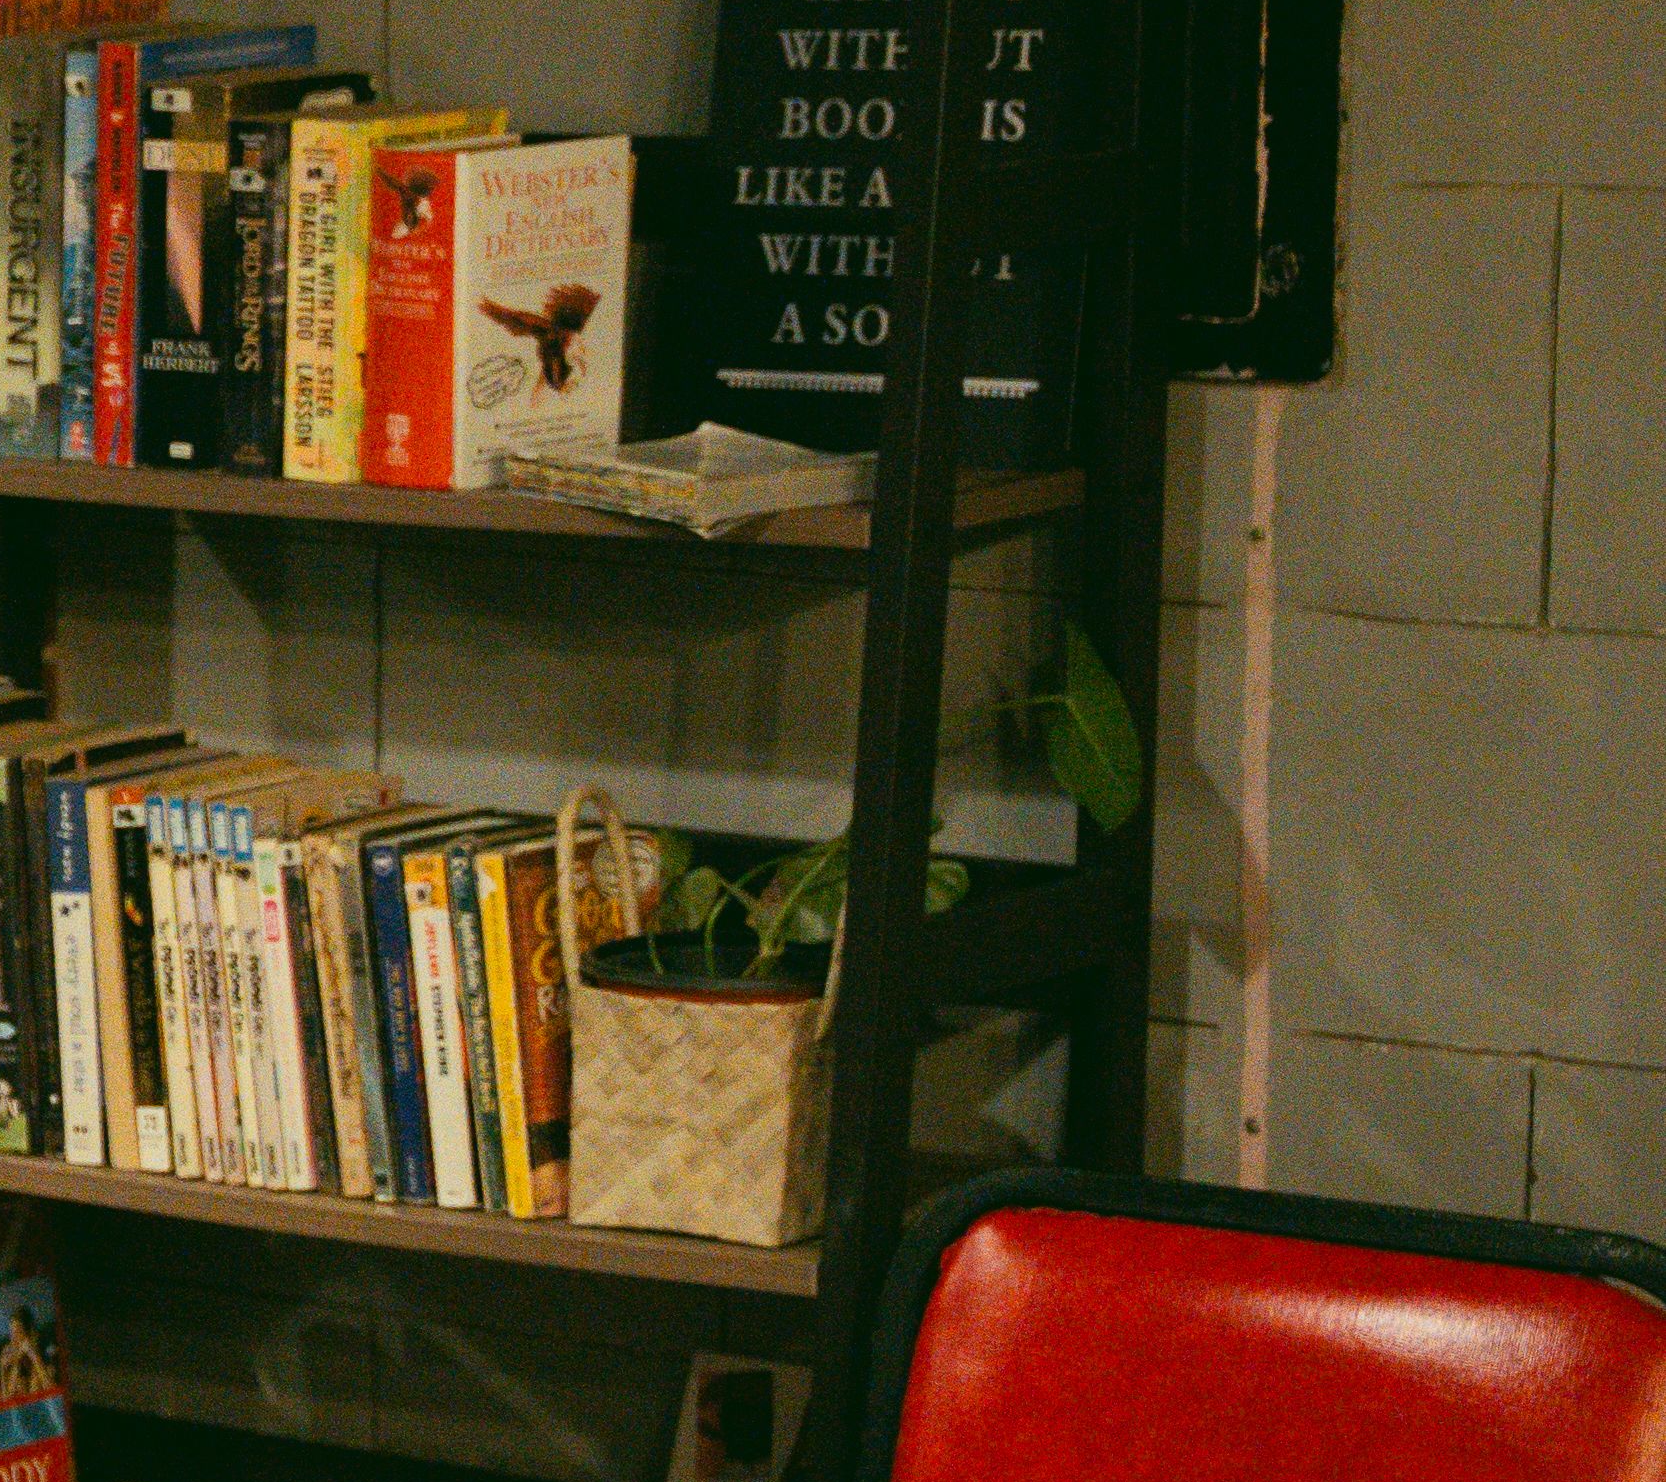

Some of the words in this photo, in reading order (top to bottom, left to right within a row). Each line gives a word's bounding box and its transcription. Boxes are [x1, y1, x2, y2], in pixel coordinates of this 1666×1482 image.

[980, 99, 1027, 142] IS
[481, 157, 621, 198] WEBSTER'S
[733, 167, 847, 208] LIKE
[5, 120, 41, 381] INSURGENT
[299, 192, 317, 269] DRAGON
[322, 213, 338, 258] GIRL
[484, 226, 610, 260] DICTIONARY
[297, 274, 315, 341] TATTOO
[319, 263, 336, 312] WITH
[317, 317, 335, 351] THE
[770, 302, 806, 345] A
[294, 363, 312, 447] LARSSON
[431, 984, 446, 1042] STEPHEN
[436, 1045, 449, 1077] KING
